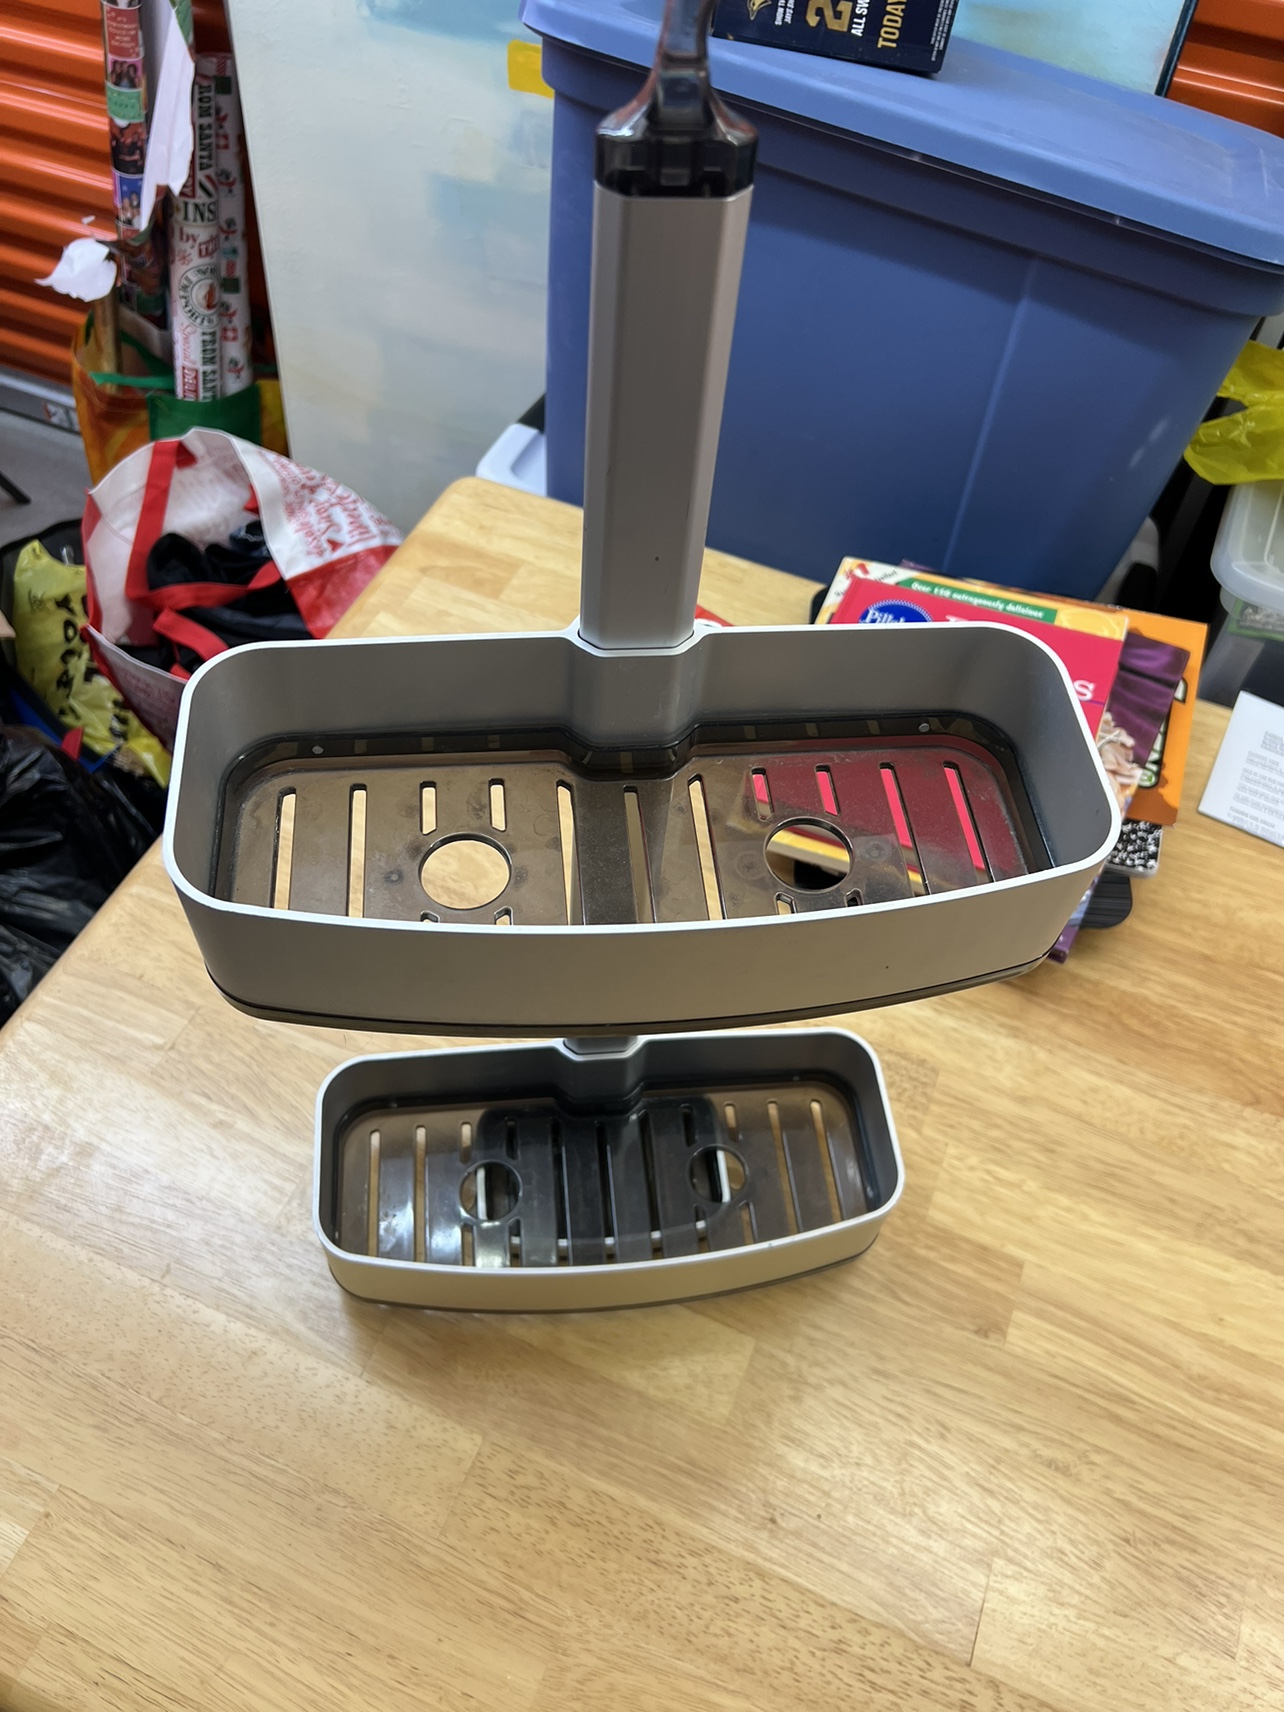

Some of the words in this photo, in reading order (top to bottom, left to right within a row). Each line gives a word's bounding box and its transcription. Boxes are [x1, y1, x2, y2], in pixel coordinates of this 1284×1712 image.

[851, 17, 866, 37] ALL
[198, 124, 213, 171] SANTA
[201, 331, 217, 366] FROM
[911, 580, 931, 592] Over
